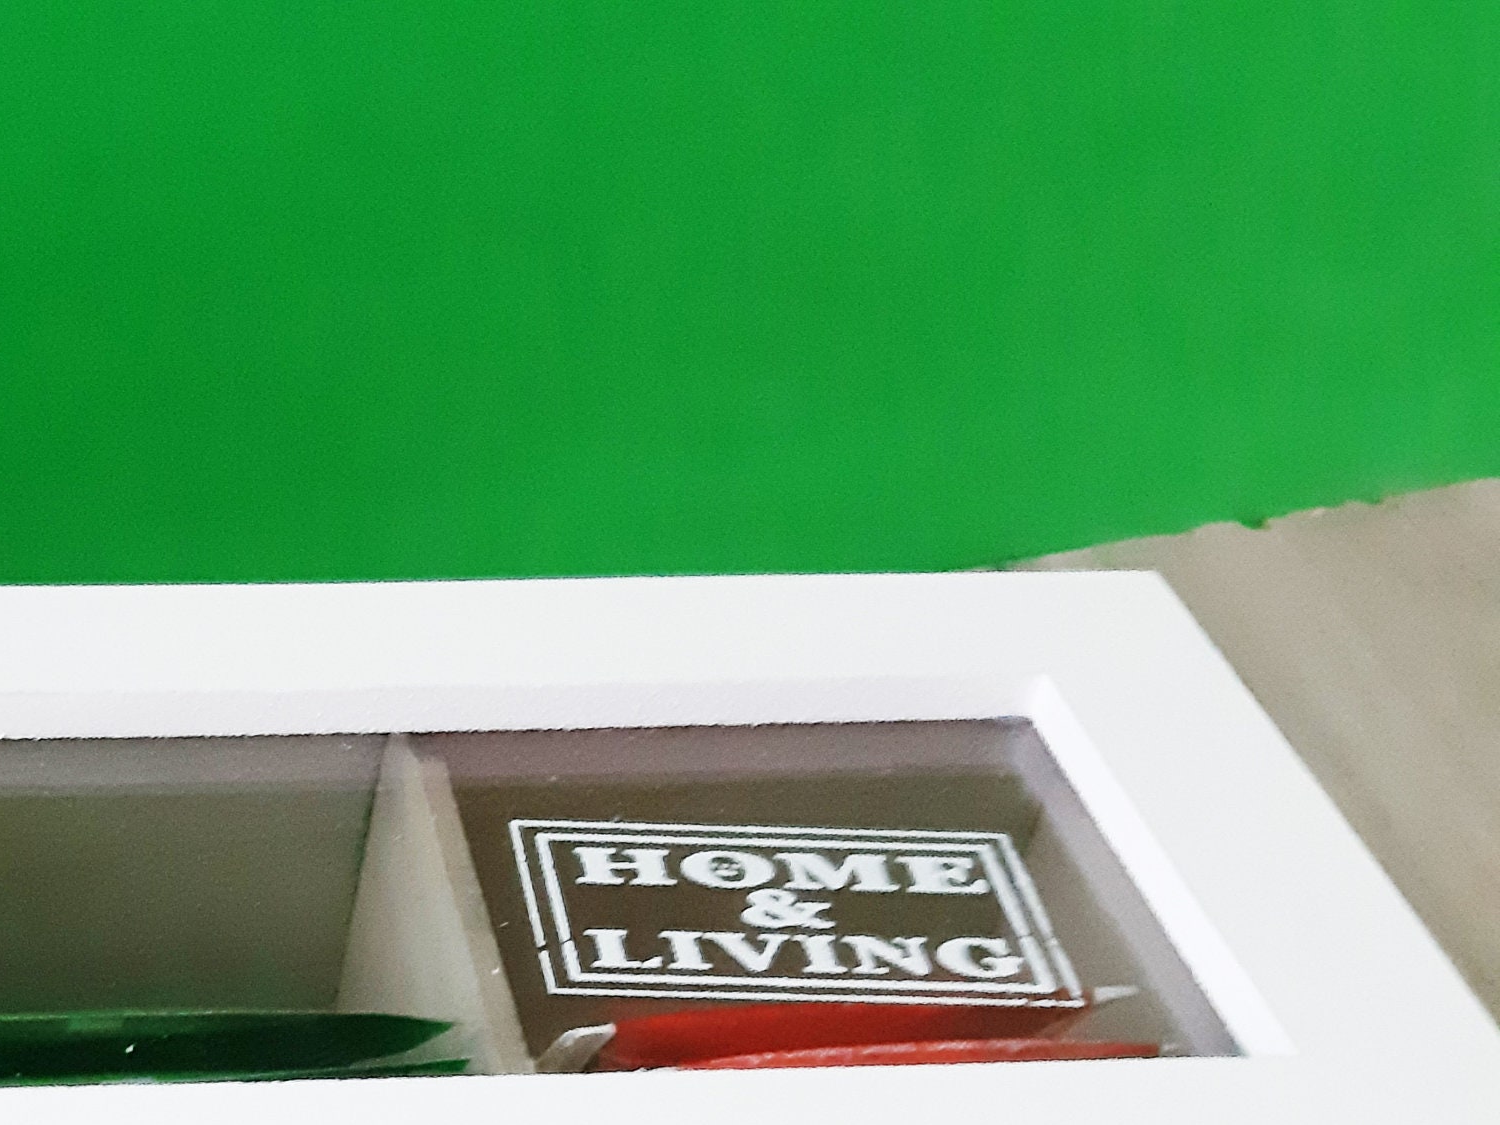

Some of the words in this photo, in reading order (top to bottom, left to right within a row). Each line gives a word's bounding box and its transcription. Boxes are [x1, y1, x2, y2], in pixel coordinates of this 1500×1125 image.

[574, 846, 991, 895] HOME
[740, 888, 836, 931] &
[583, 926, 1025, 979] LIVING
